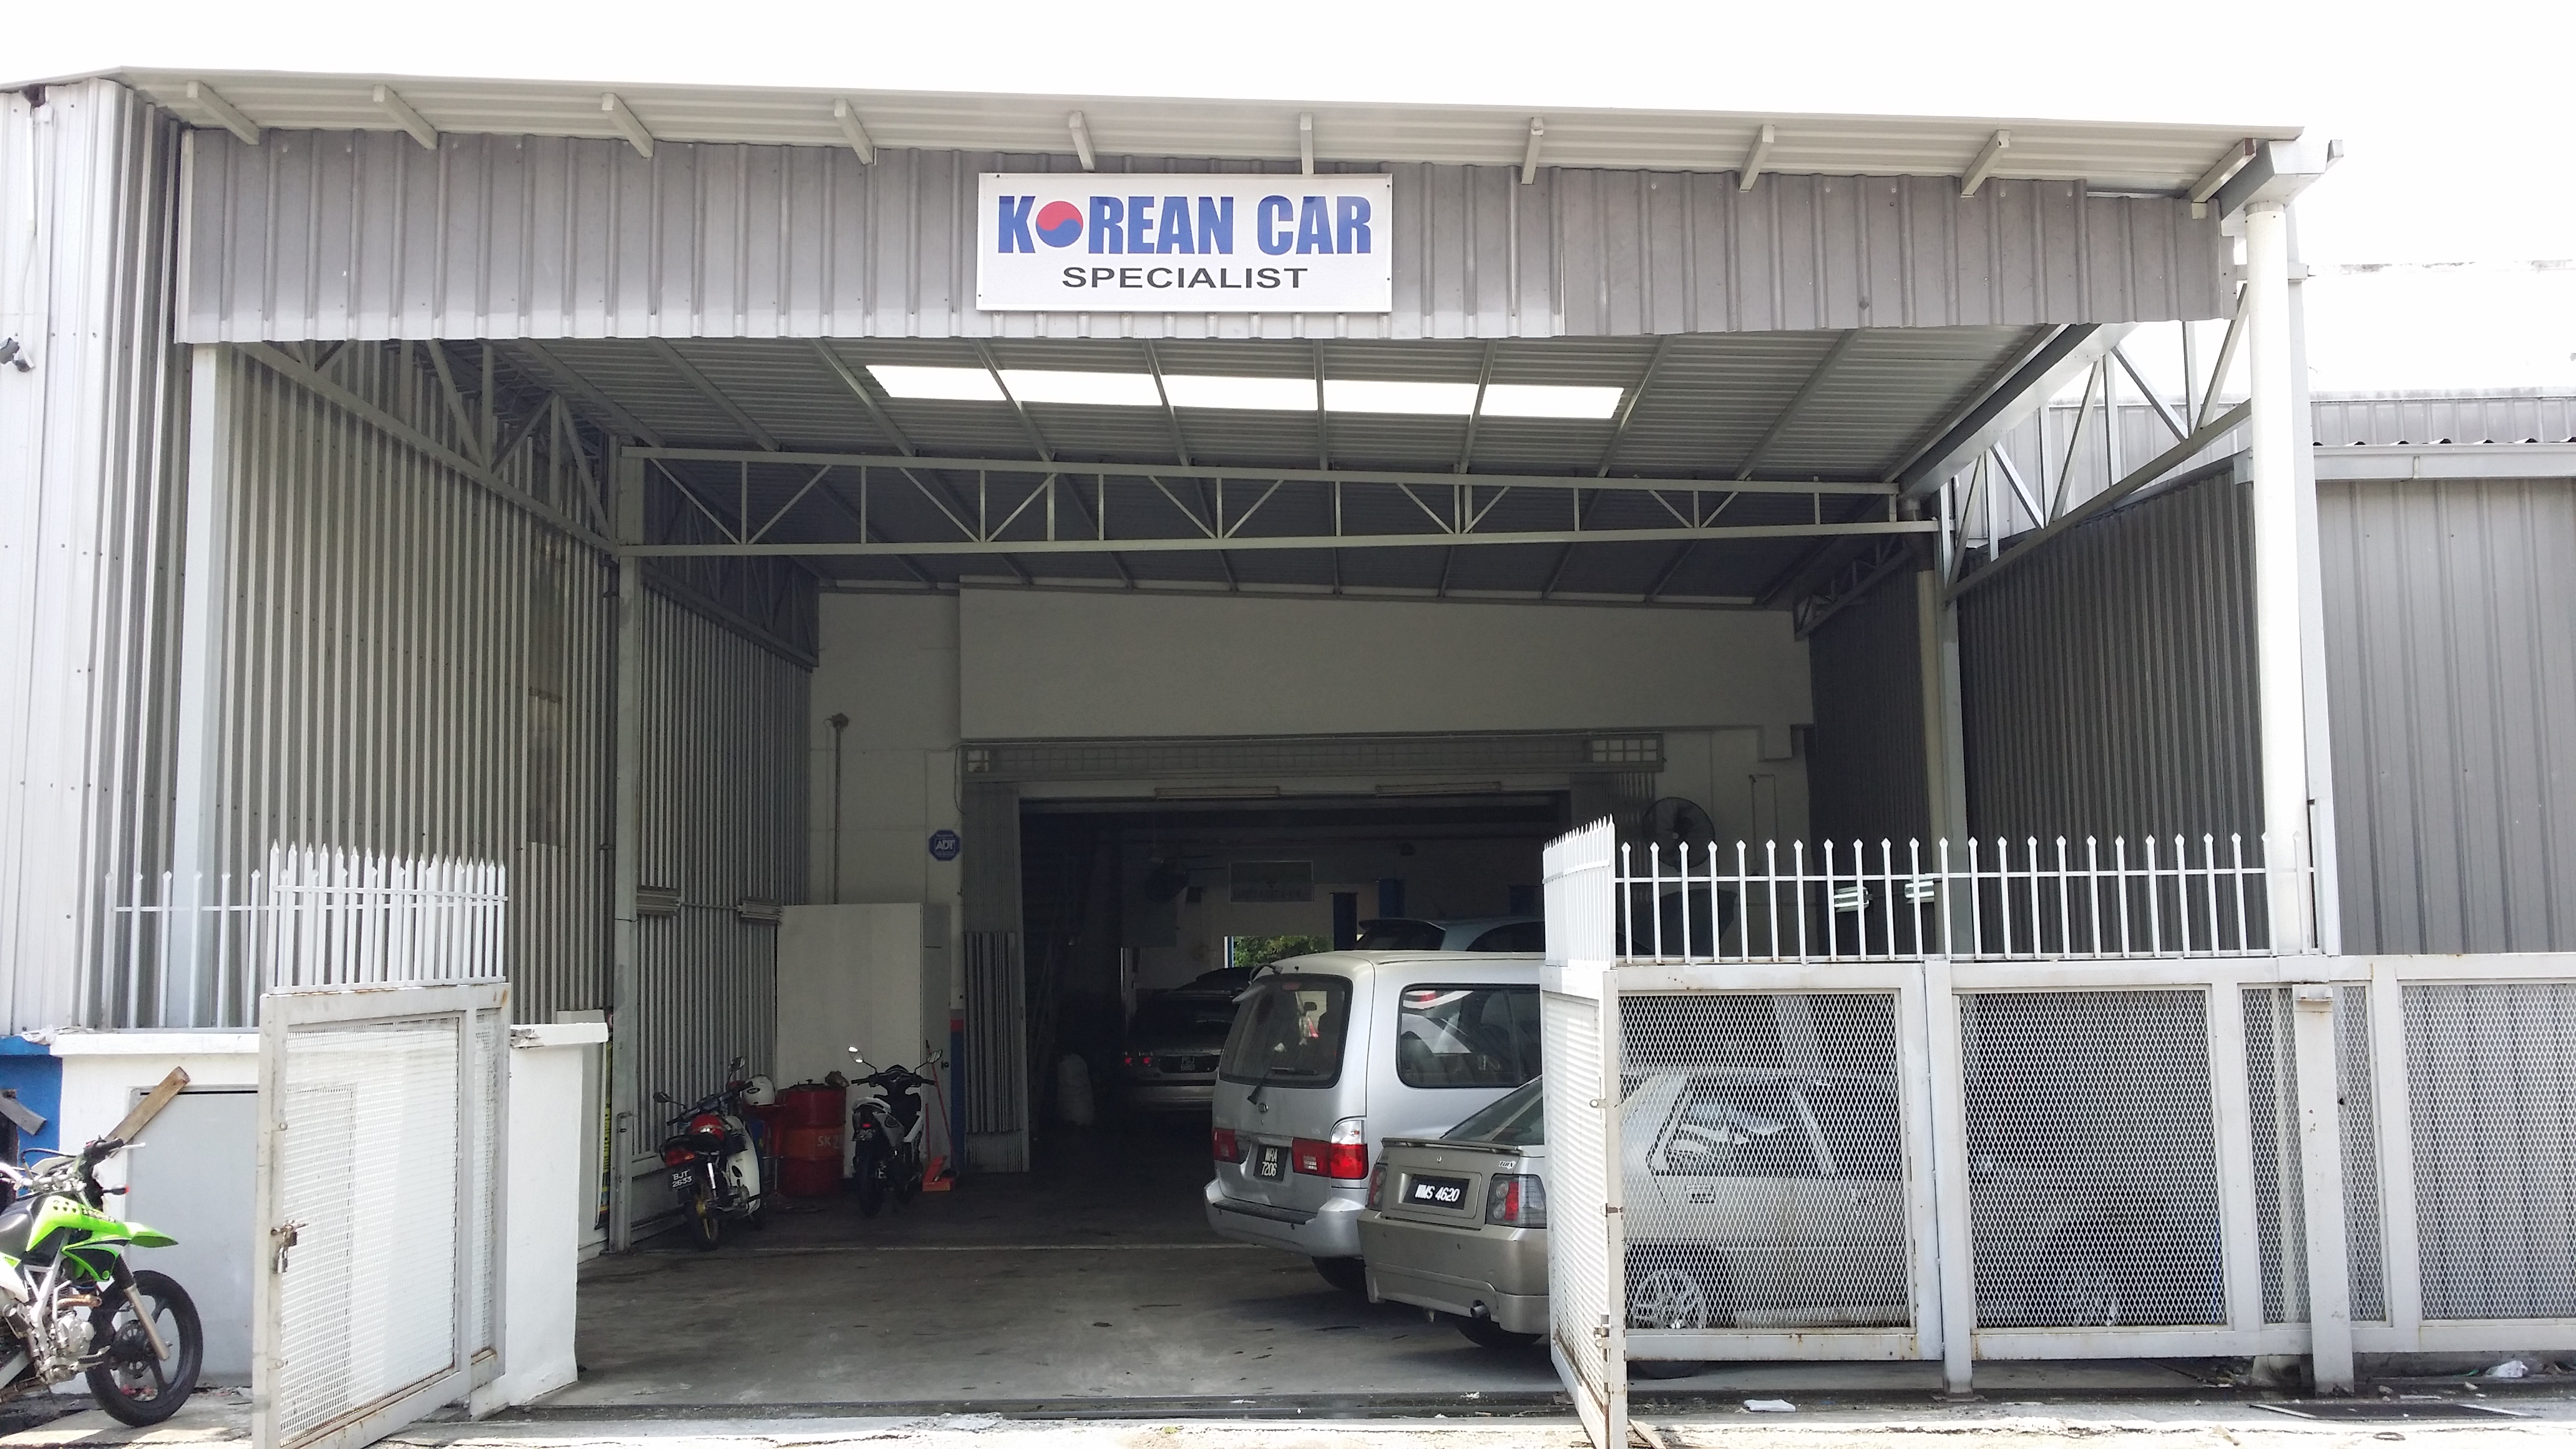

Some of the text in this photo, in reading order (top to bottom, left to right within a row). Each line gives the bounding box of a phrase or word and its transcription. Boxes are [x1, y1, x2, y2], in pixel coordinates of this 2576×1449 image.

[998, 195, 1372, 256] KOREAN CAR
[1061, 266, 1309, 289] SPECIALIST
[935, 839, 955, 850] ADT
[1265, 1148, 1277, 1162] WRA
[672, 1169, 691, 1181] BJT
[1261, 1161, 1277, 1177] 7206
[671, 1175, 693, 1188] 2633
[1415, 1184, 1461, 1203] WMS 4620
